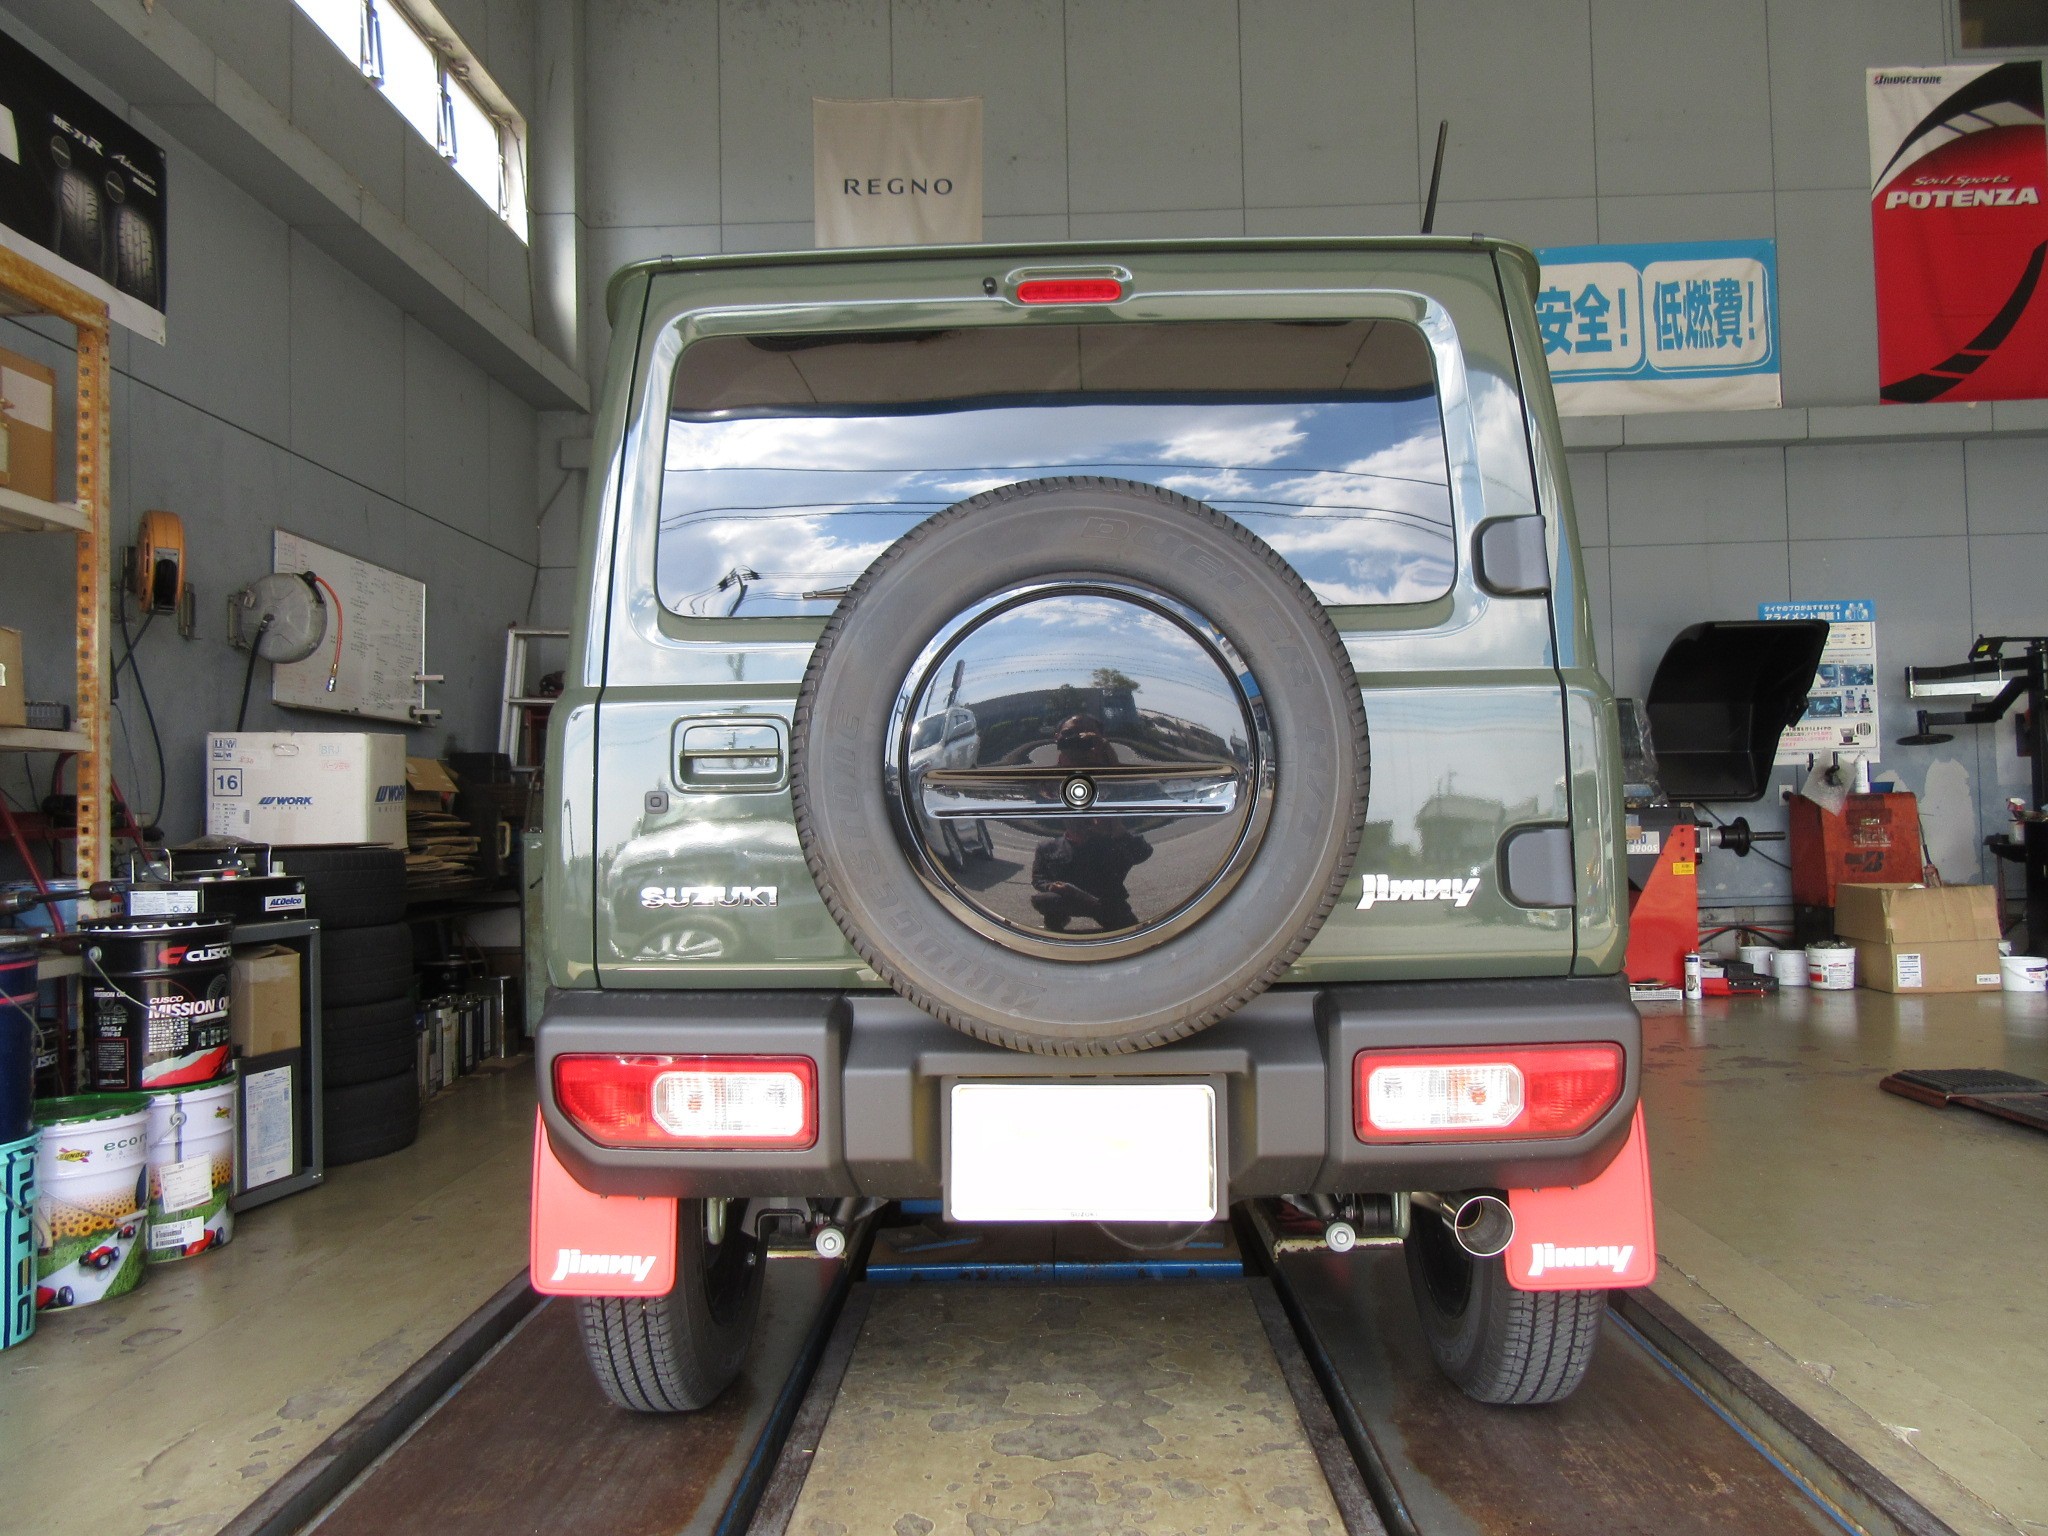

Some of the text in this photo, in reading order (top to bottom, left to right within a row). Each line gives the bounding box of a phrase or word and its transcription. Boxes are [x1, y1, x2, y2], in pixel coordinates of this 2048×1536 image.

[1873, 74, 1942, 86] BRIDGESTONE
[843, 177, 954, 196] REGNO
[1911, 174, 2011, 188] Soul Sports
[1884, 186, 2040, 211] POTENZA
[1652, 277, 1756, 352] 低燃費!
[216, 774, 238, 790] 16
[276, 796, 313, 805] WORK
[641, 886, 778, 908] SUZUKI
[1356, 874, 1480, 909] Jimny
[270, 897, 302, 906] ACDelco
[149, 1000, 215, 1019] MISSION
[150, 995, 184, 1005] CUSCO
[57, 1149, 92, 1161] SUNOCO
[550, 1249, 657, 1282] Jimny
[1527, 1242, 1634, 1276] Jimny
